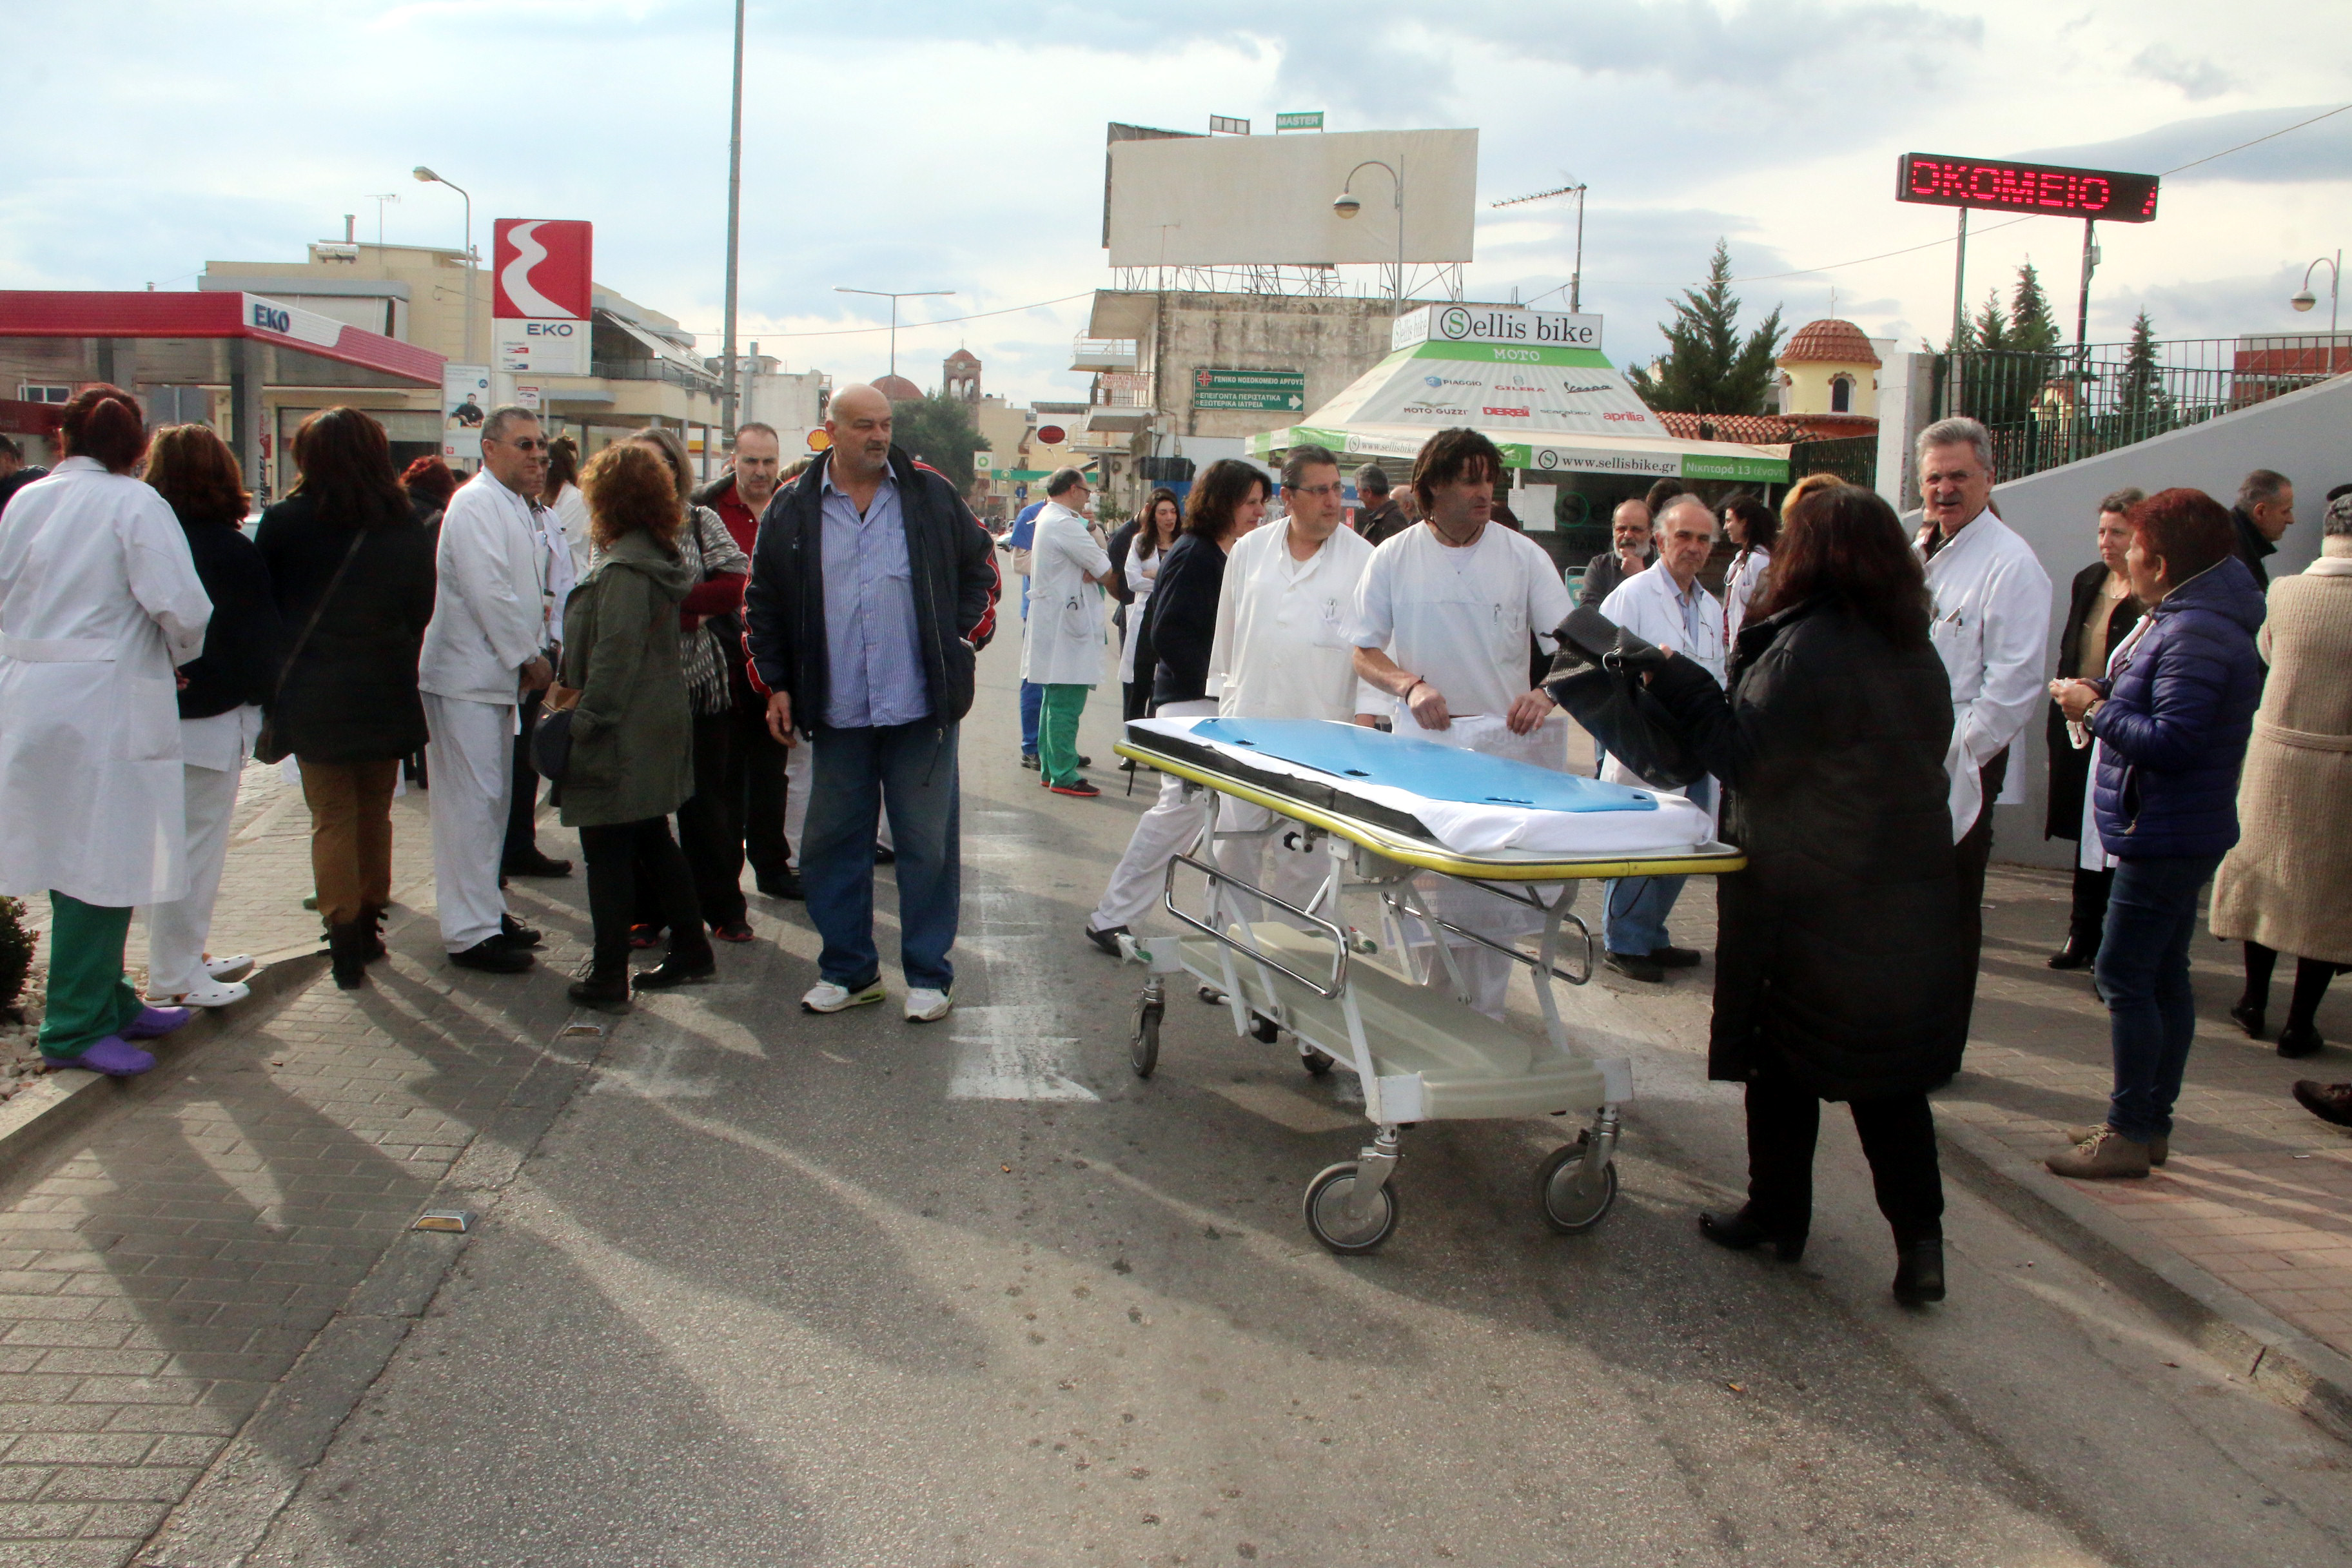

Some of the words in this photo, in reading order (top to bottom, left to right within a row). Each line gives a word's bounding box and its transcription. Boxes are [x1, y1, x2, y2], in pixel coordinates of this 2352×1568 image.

[1277, 115, 1319, 126] MASTER
[254, 303, 290, 333] EKO
[527, 323, 573, 337] EKO
[1448, 311, 1526, 340] Sellis
[1536, 316, 1593, 343] bike
[1493, 348, 1540, 362] MOTO
[1237, 377, 1279, 385] ΝΟΣΟΚΟΜΕΙΟ
[1603, 411, 1645, 422] aprilia
[1562, 456, 1676, 473] www.sellisbike.gr
[1686, 462, 1734, 475] Νικηταρά
[1738, 465, 1750, 475] 13
